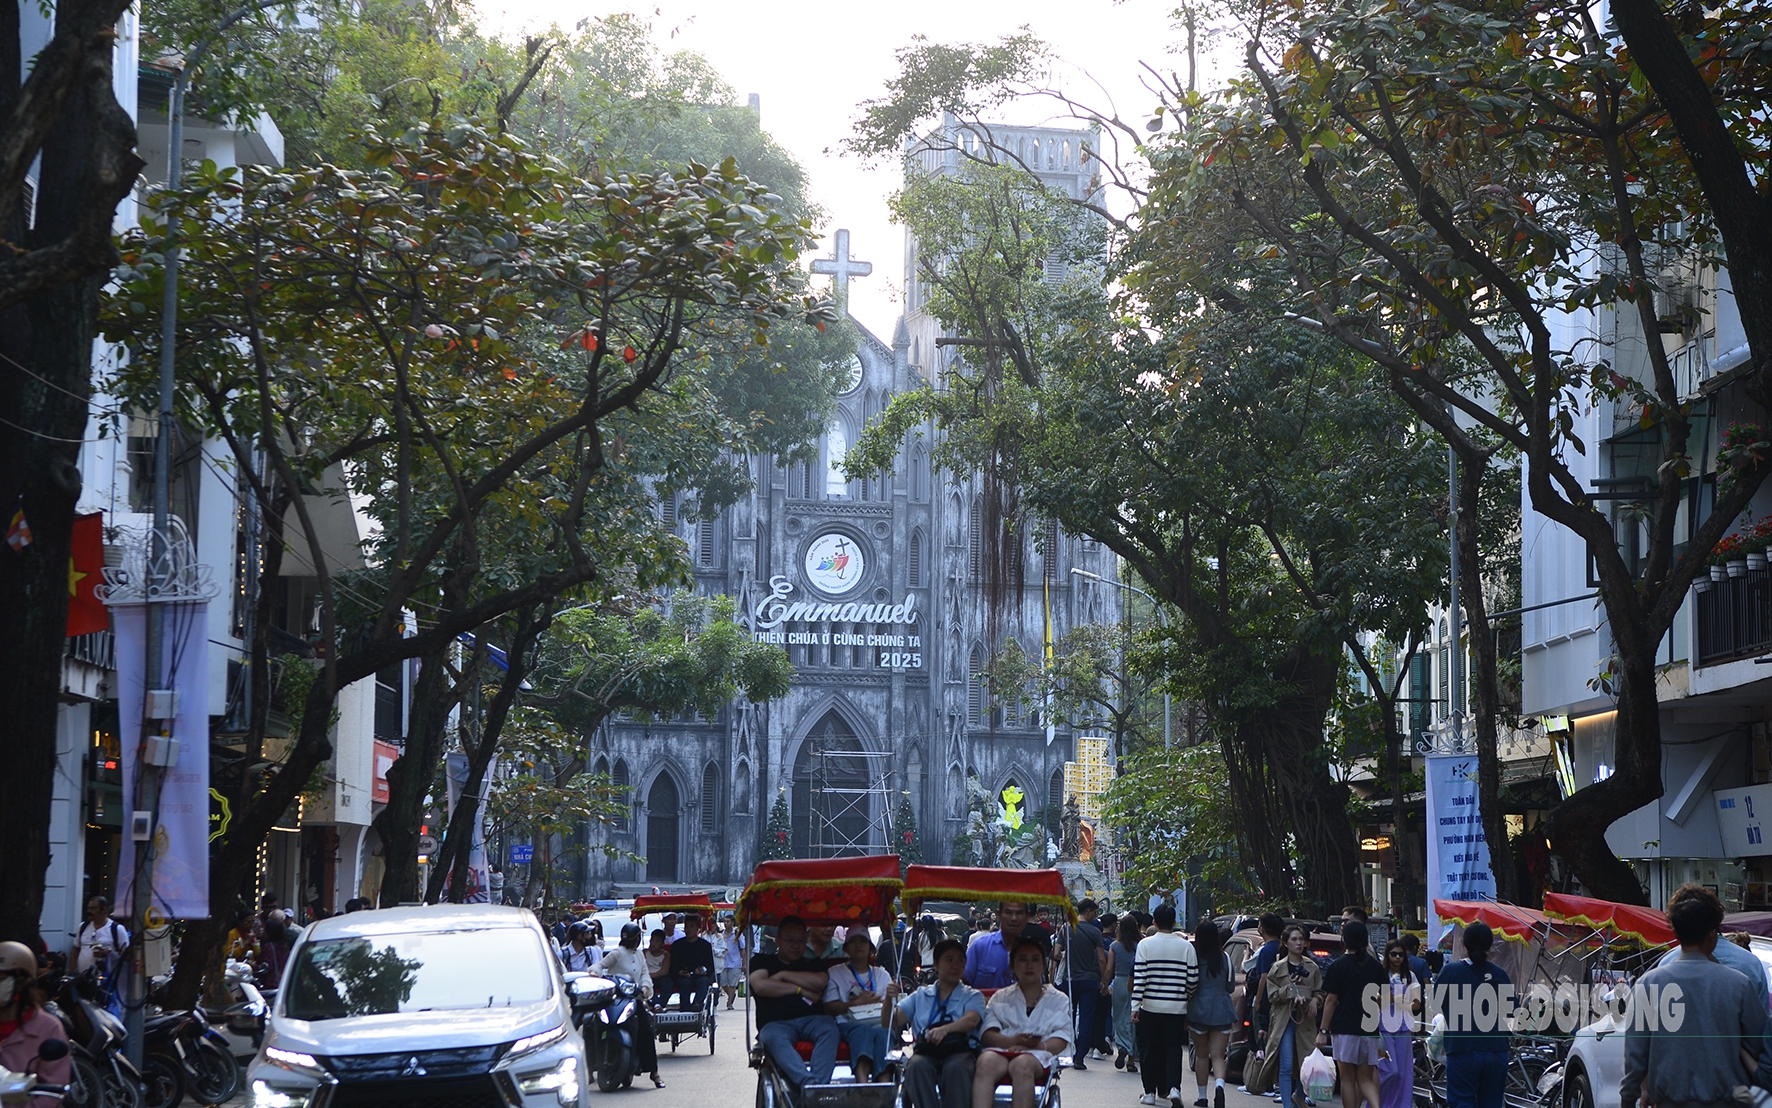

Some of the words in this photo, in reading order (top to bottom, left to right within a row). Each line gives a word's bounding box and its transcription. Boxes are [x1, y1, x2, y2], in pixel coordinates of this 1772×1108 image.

[755, 574, 916, 629] Emmanuel
[788, 631, 818, 645] CHÚA
[822, 629, 830, 645] Ở
[833, 631, 864, 646] CÙNG
[867, 633, 904, 647] CHÚNG
[908, 636, 921, 647] TA
[880, 652, 922, 668] 2025
[1744, 795, 1754, 818] 12
[1457, 816, 1466, 825] TAY
